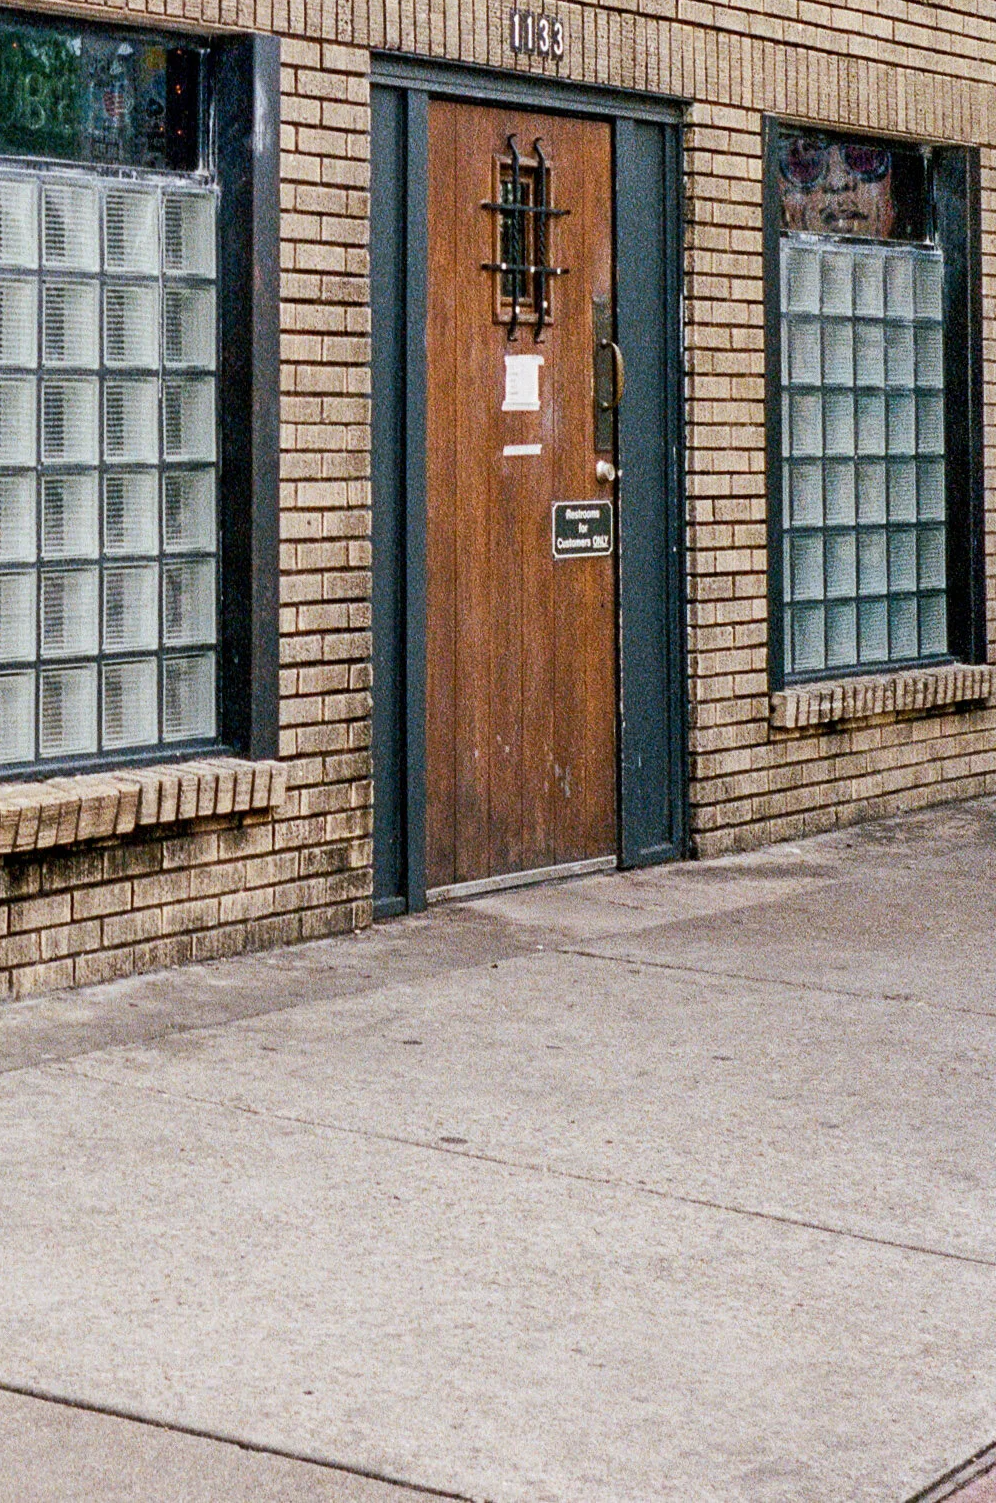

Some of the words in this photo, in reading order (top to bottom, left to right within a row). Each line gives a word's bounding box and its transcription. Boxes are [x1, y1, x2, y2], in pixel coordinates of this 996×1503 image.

[513, 14, 563, 55] 1133
[565, 509, 600, 520] Restrooms
[557, 537, 591, 549] Customers
[592, 535, 609, 548] ONLY
